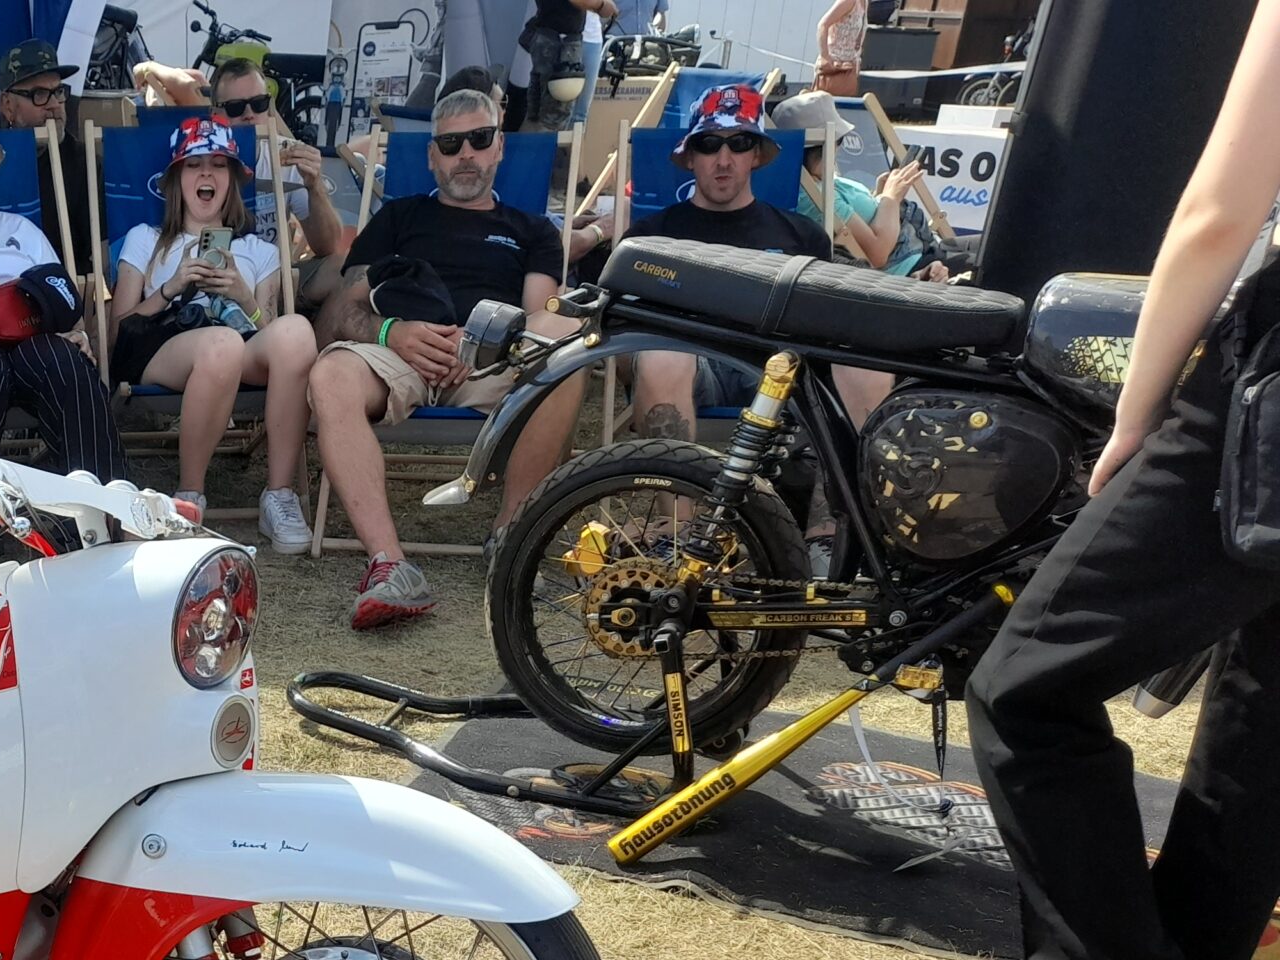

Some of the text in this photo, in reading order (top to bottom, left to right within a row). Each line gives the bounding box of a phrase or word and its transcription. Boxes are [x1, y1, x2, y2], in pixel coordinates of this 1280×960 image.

[633, 260, 677, 280] CARBON
[767, 614, 808, 622] CARBON
[670, 690, 685, 737] SIMSON
